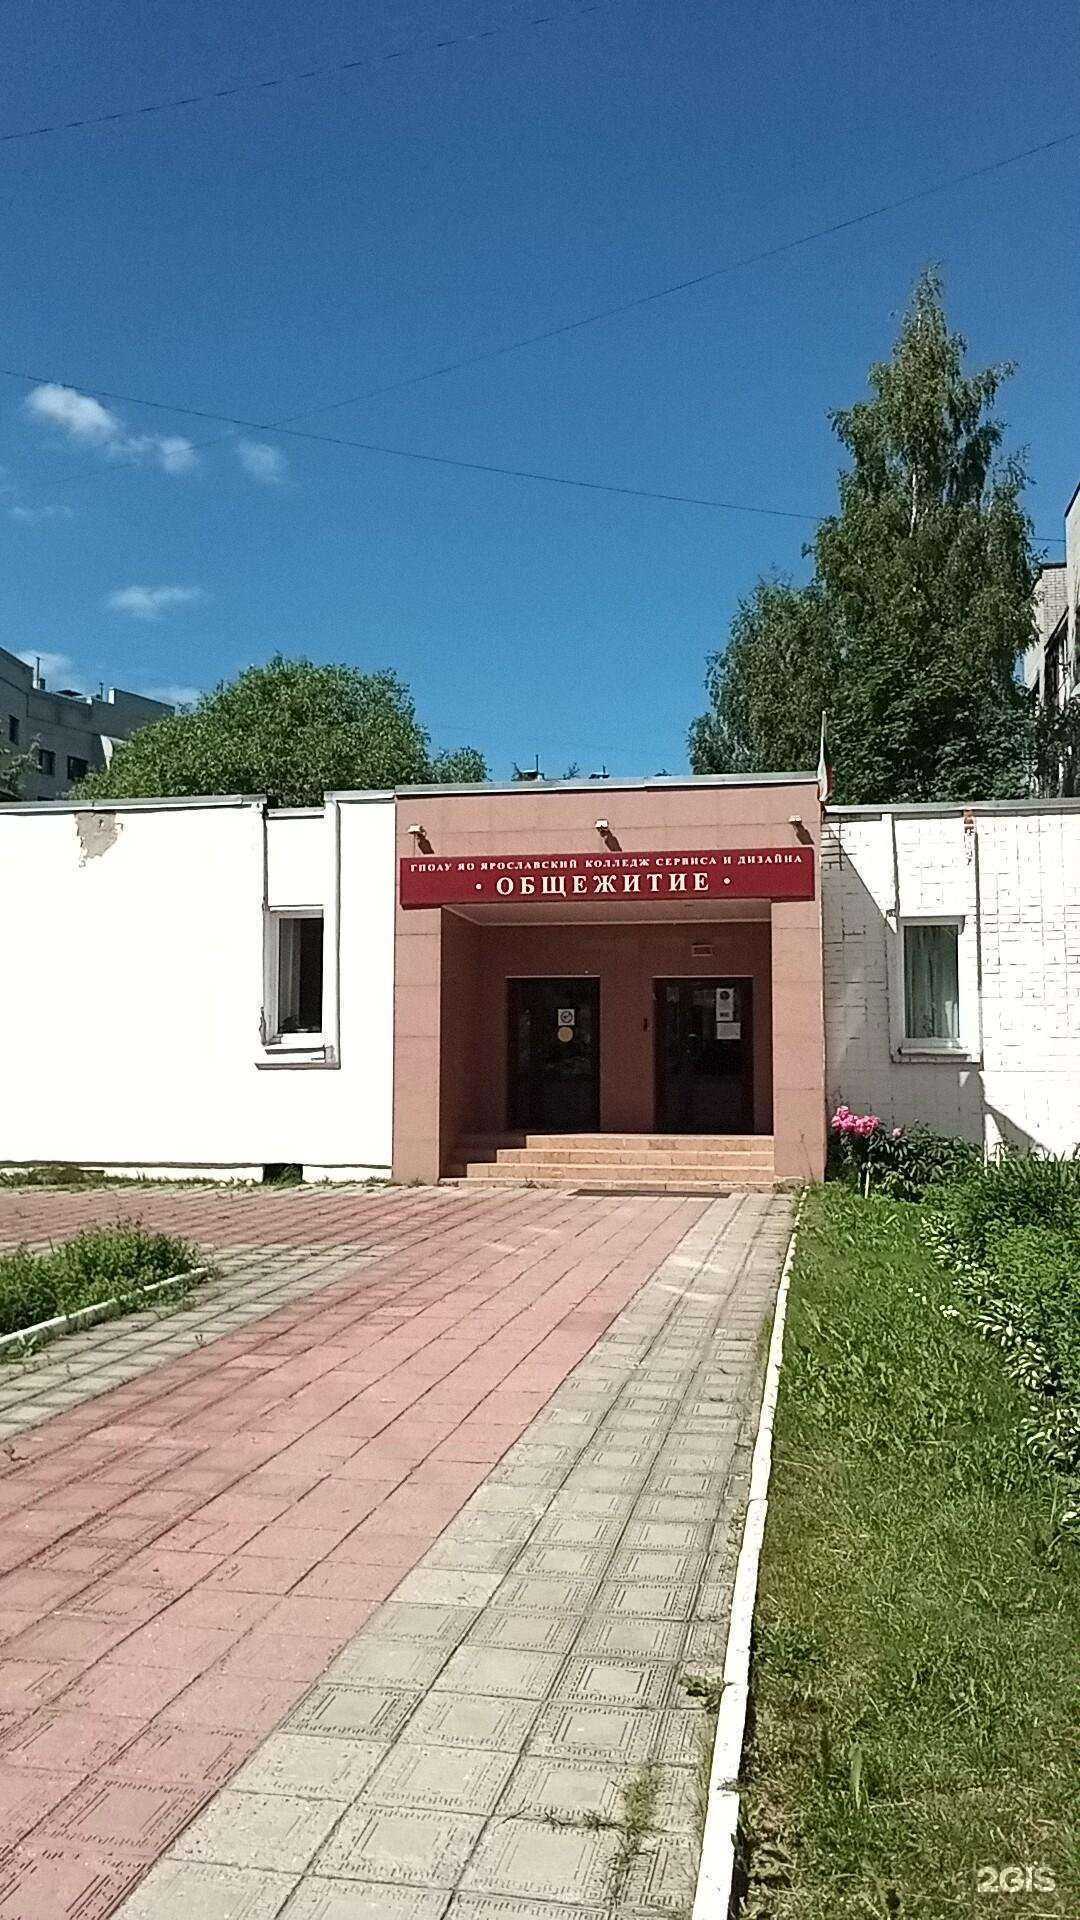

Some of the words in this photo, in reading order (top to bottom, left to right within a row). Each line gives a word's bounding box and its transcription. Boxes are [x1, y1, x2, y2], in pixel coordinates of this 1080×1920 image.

[410, 863, 452, 872] ГПОАУ
[457, 862, 475, 871] ЯО
[480, 859, 577, 871] ЯРОСЛАВСКИЙ
[585, 857, 650, 868] КОЛЛЕДЖ
[655, 856, 717, 866] СЕРВИСА
[723, 855, 732, 864] И
[737, 853, 803, 865] ДИЗАЙНА
[496, 872, 709, 897] ОБЩЕЖИТИЕ
